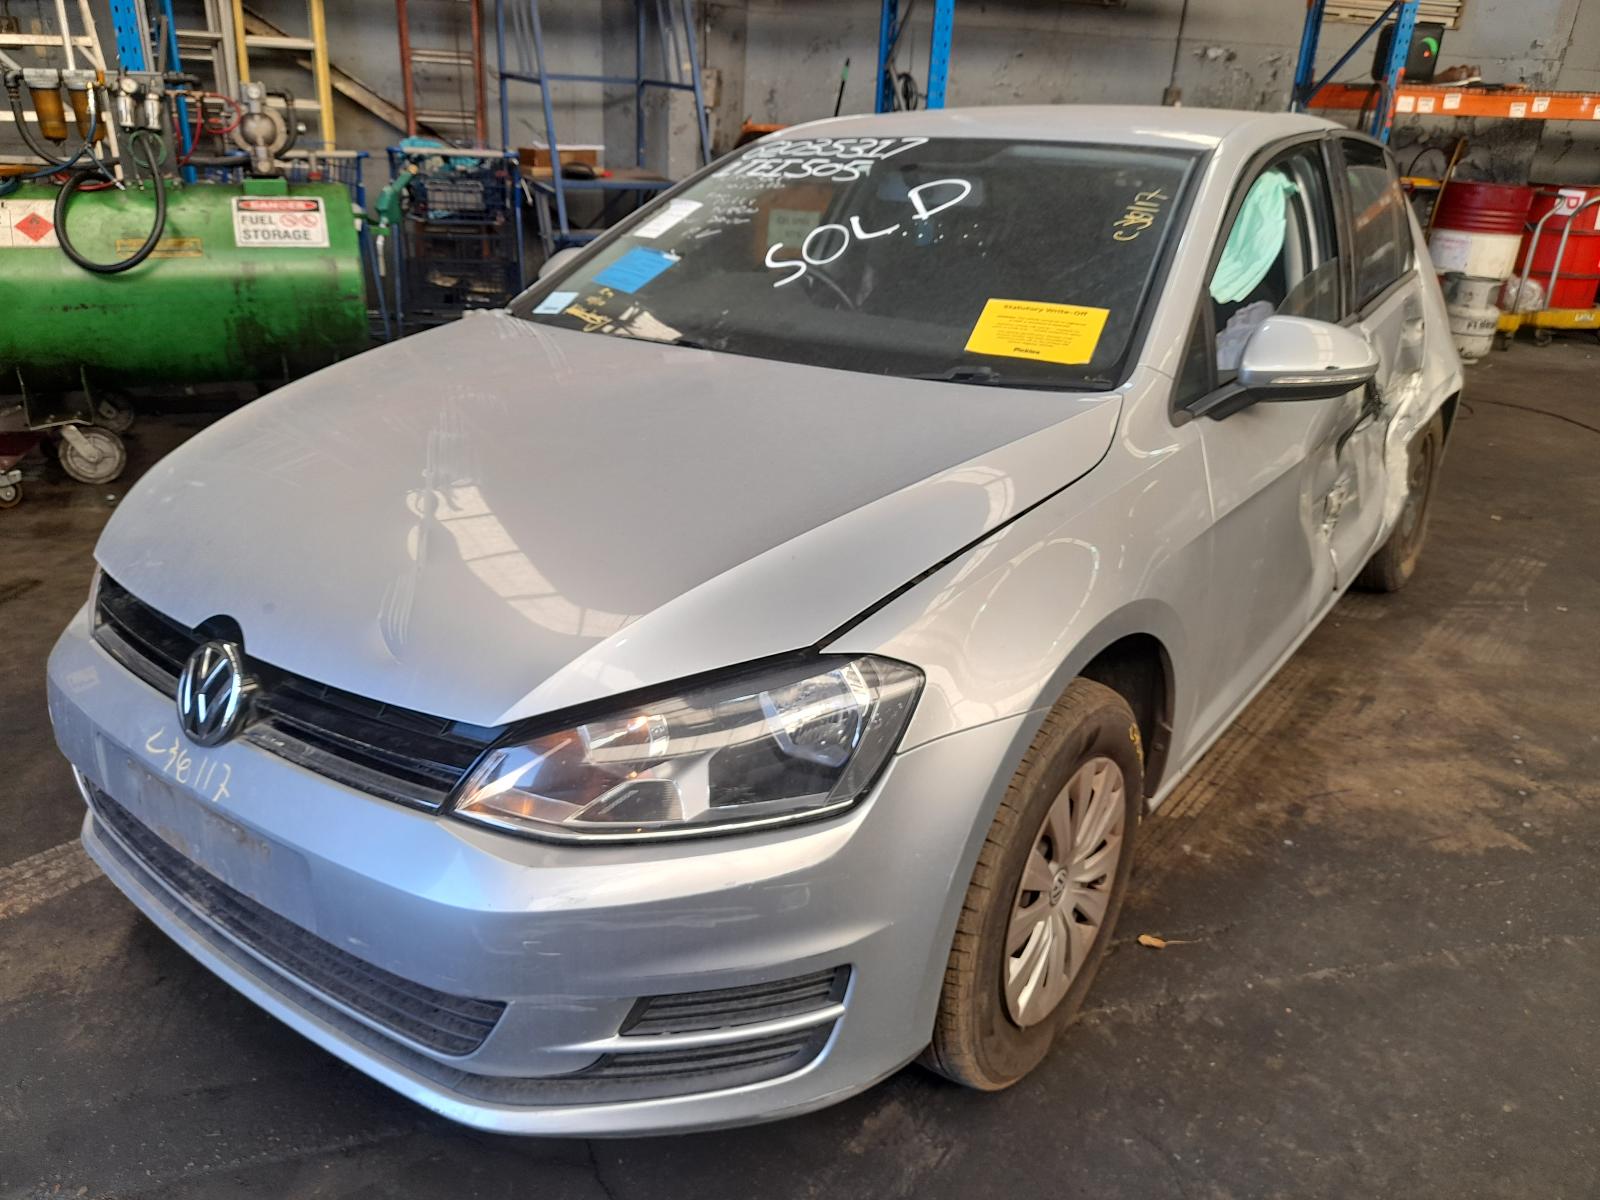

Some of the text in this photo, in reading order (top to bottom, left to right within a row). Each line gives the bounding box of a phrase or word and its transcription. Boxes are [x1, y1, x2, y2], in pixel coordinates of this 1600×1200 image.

[241, 215, 276, 225] FUEL
[243, 230, 311, 241] STORAGE
[765, 178, 972, 288] SOLD
